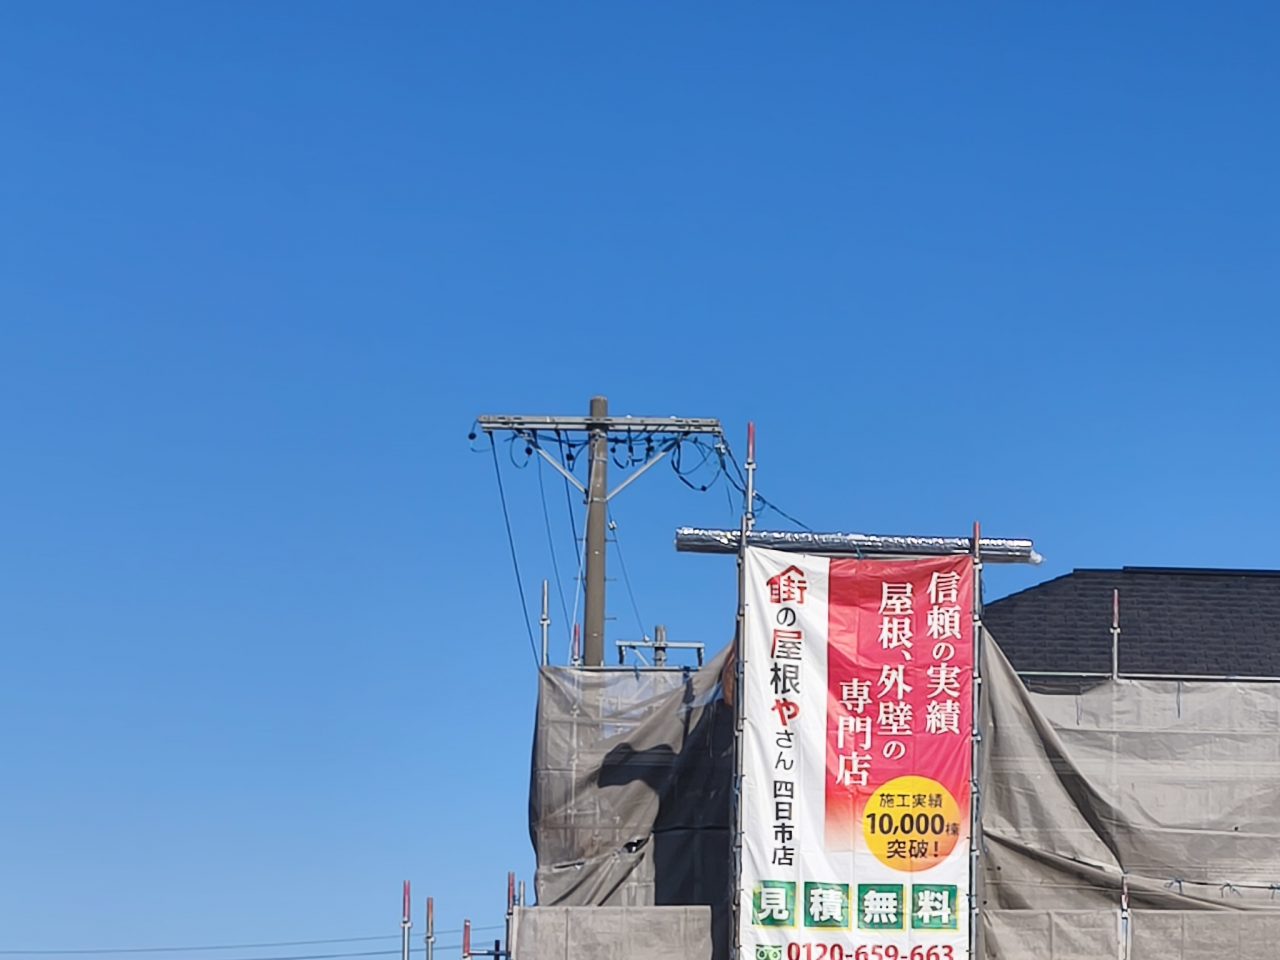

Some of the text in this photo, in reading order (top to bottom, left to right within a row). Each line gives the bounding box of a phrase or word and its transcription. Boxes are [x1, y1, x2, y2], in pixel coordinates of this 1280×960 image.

[766, 565, 807, 866] 街の屋根やさん 四日市店
[876, 582, 914, 760] 屋根、外壁の
[925, 571, 961, 735] 信頼の実績
[834, 678, 873, 787] 専門店
[879, 793, 943, 808] 施工実績
[758, 887, 951, 924] 見積無料
